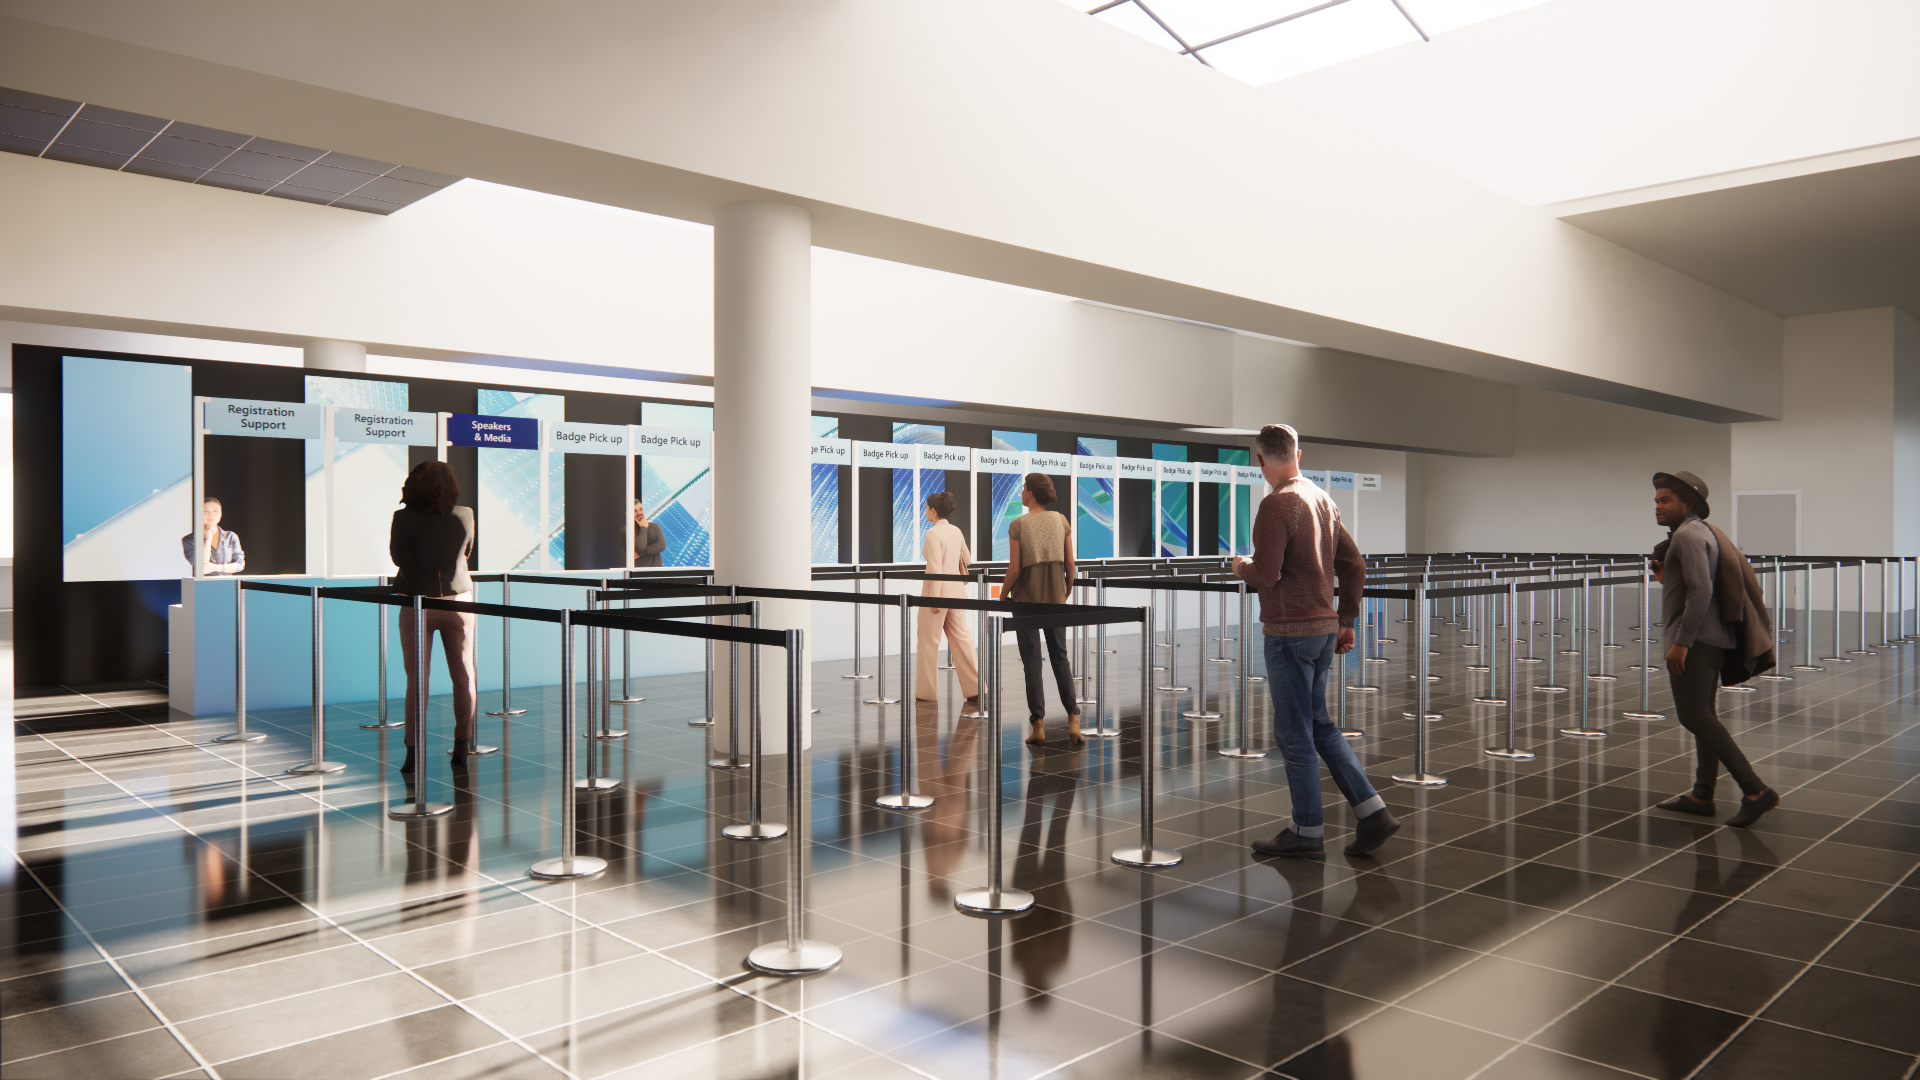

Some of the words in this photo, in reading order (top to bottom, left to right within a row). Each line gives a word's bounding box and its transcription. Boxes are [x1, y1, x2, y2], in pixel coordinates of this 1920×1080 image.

[228, 404, 295, 418] Registration
[240, 418, 286, 432] Support
[354, 414, 414, 426] Registration
[366, 426, 406, 438] Support
[471, 420, 512, 433] Speakers
[474, 432, 482, 442] &
[484, 433, 512, 443] Media
[556, 431, 586, 444] Badge
[589, 433, 608, 442] Pick
[610, 436, 622, 446] up
[641, 434, 668, 446] Badge
[670, 436, 688, 446] Pick
[690, 440, 701, 448] up
[820, 446, 834, 454] Pick
[836, 448, 846, 456] up
[864, 449, 884, 460] Badge
[886, 450, 898, 459] Pick
[900, 452, 908, 460] up
[924, 452, 942, 462] Badge
[944, 452, 956, 460] Pick
[980, 456, 998, 466] Badge
[1032, 458, 1048, 467] Badge
[1048, 458, 1059, 466] Pick
[1080, 462, 1094, 470] Badge
[1122, 464, 1136, 472] Badge
[1201, 468, 1213, 476] Badge
